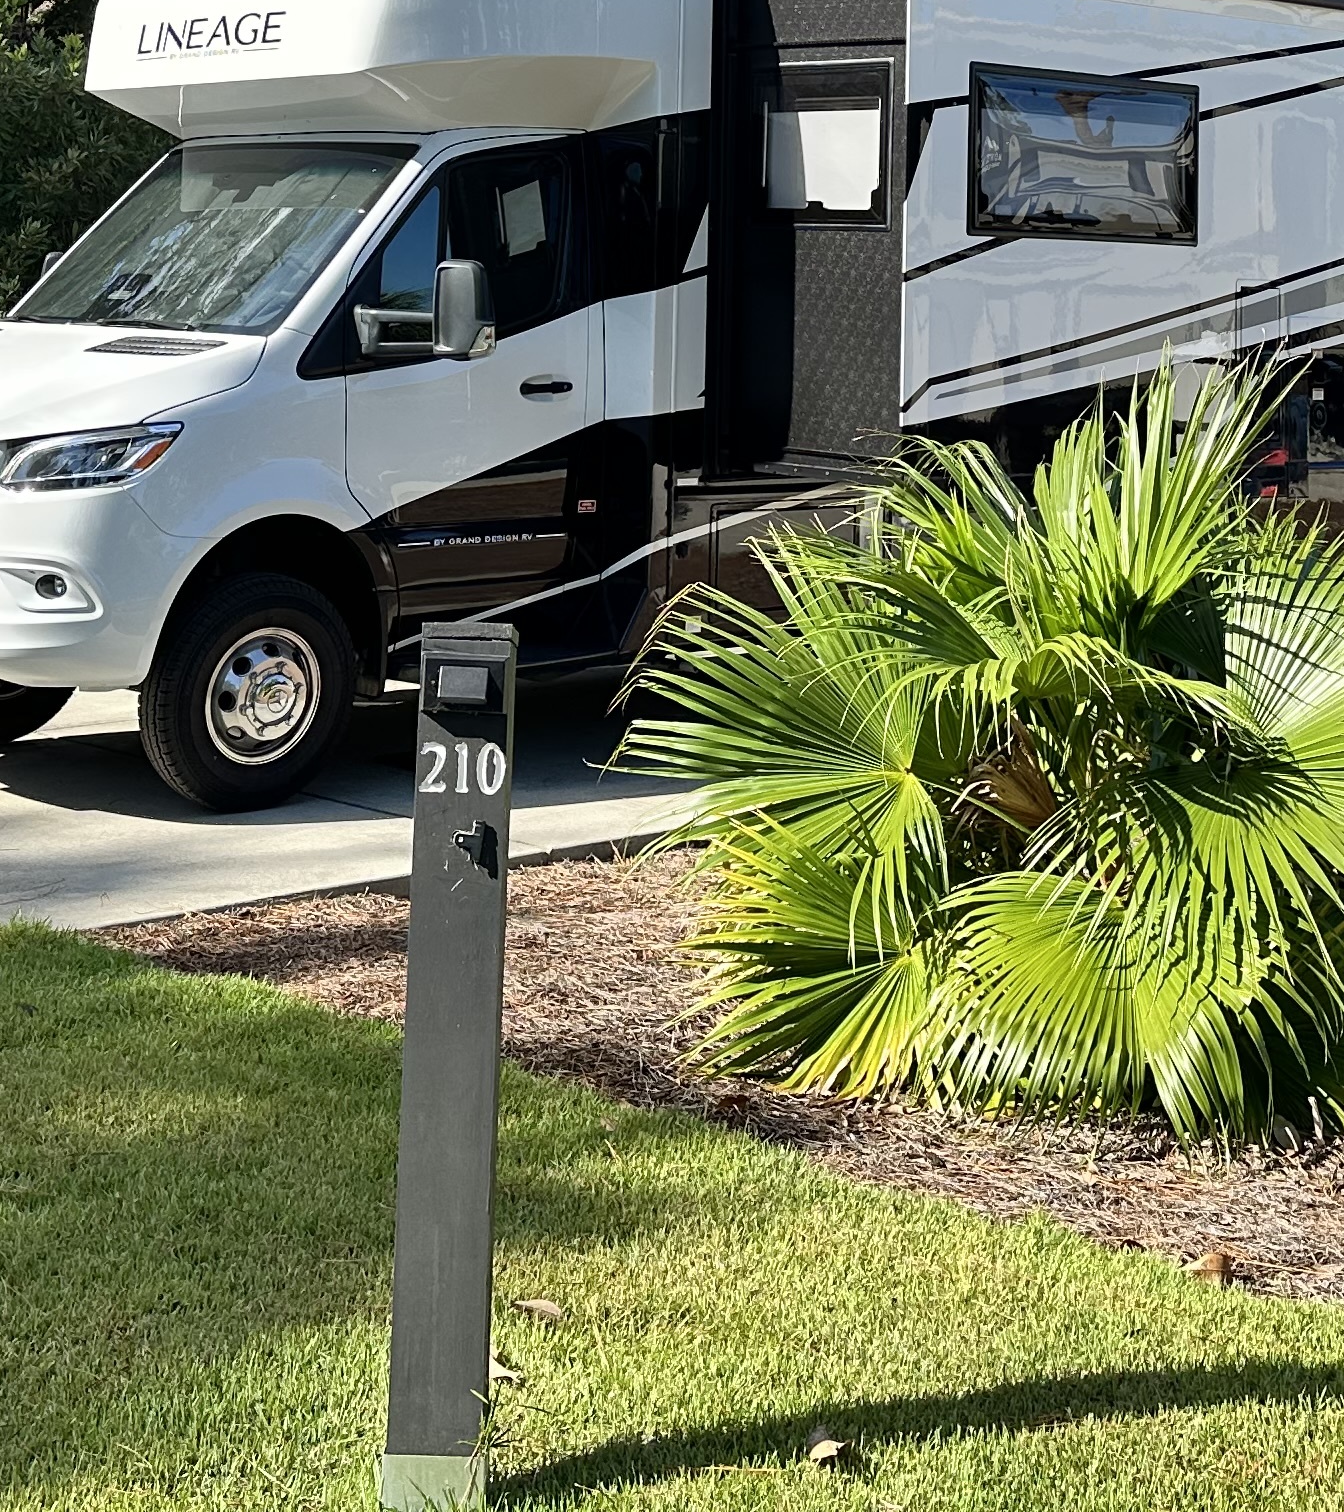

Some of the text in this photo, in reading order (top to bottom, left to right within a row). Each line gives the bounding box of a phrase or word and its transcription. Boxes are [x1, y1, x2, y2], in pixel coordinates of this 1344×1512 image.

[137, 11, 287, 55] LINEAGE
[433, 533, 533, 547] BY GRAND DESIGN RV
[418, 741, 507, 796] 210
